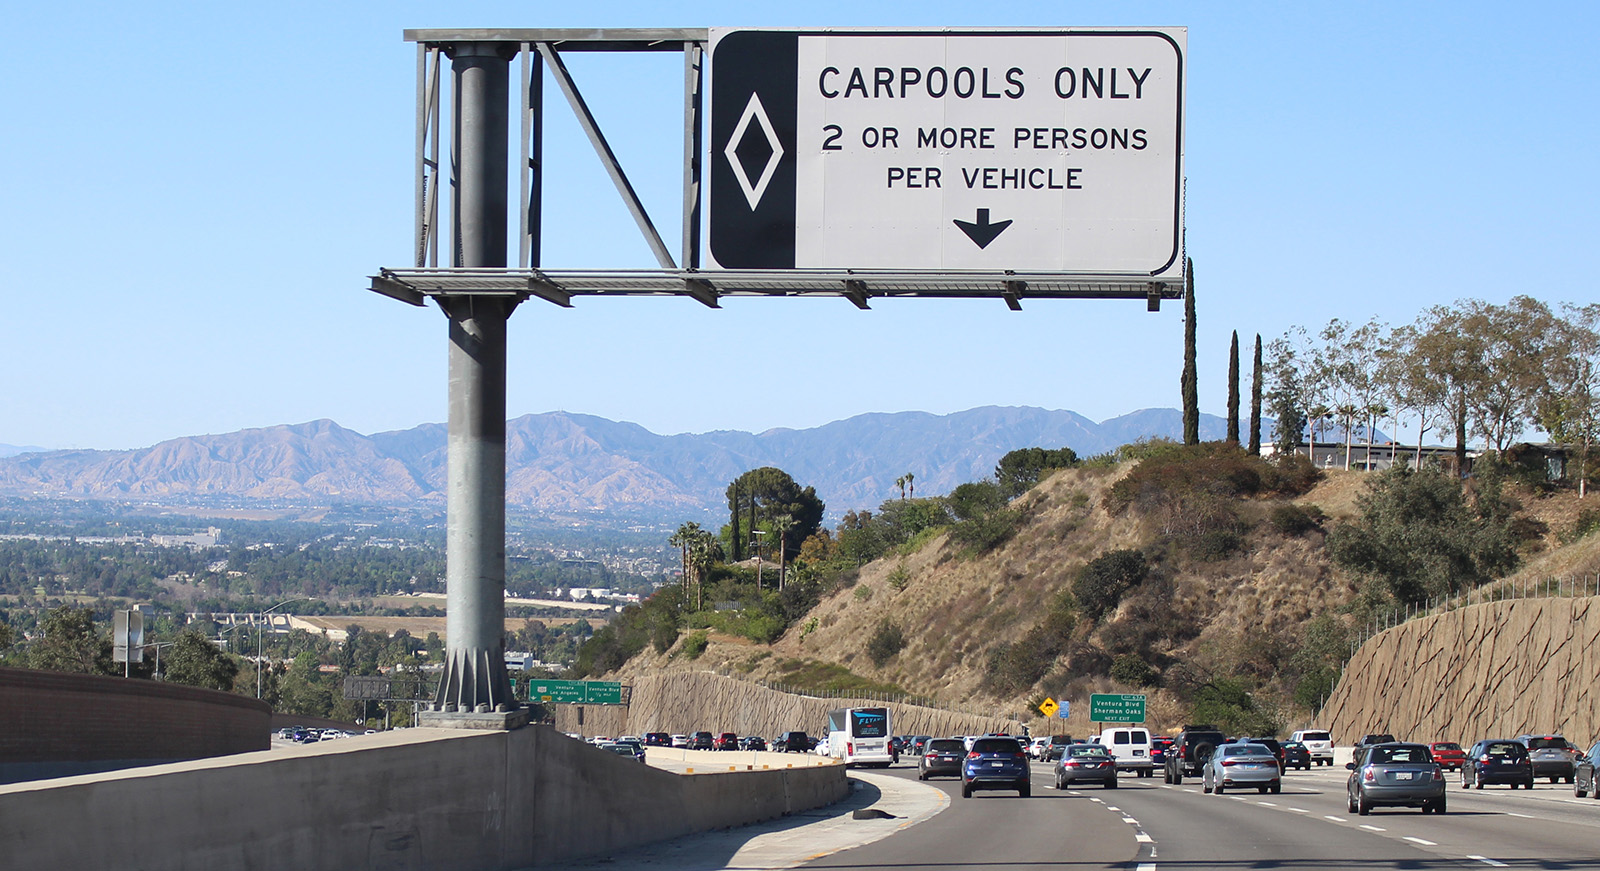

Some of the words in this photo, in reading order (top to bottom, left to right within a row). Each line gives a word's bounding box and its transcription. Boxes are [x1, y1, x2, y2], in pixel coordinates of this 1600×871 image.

[819, 66, 1025, 100] CARPOOLS
[1054, 66, 1152, 100] ONLY
[822, 124, 843, 151] 2
[862, 126, 899, 149] OR
[917, 127, 995, 149] MORE
[1014, 127, 1148, 151] PERSONS
[887, 167, 942, 189] PER
[961, 167, 1083, 190] VEHICLE
